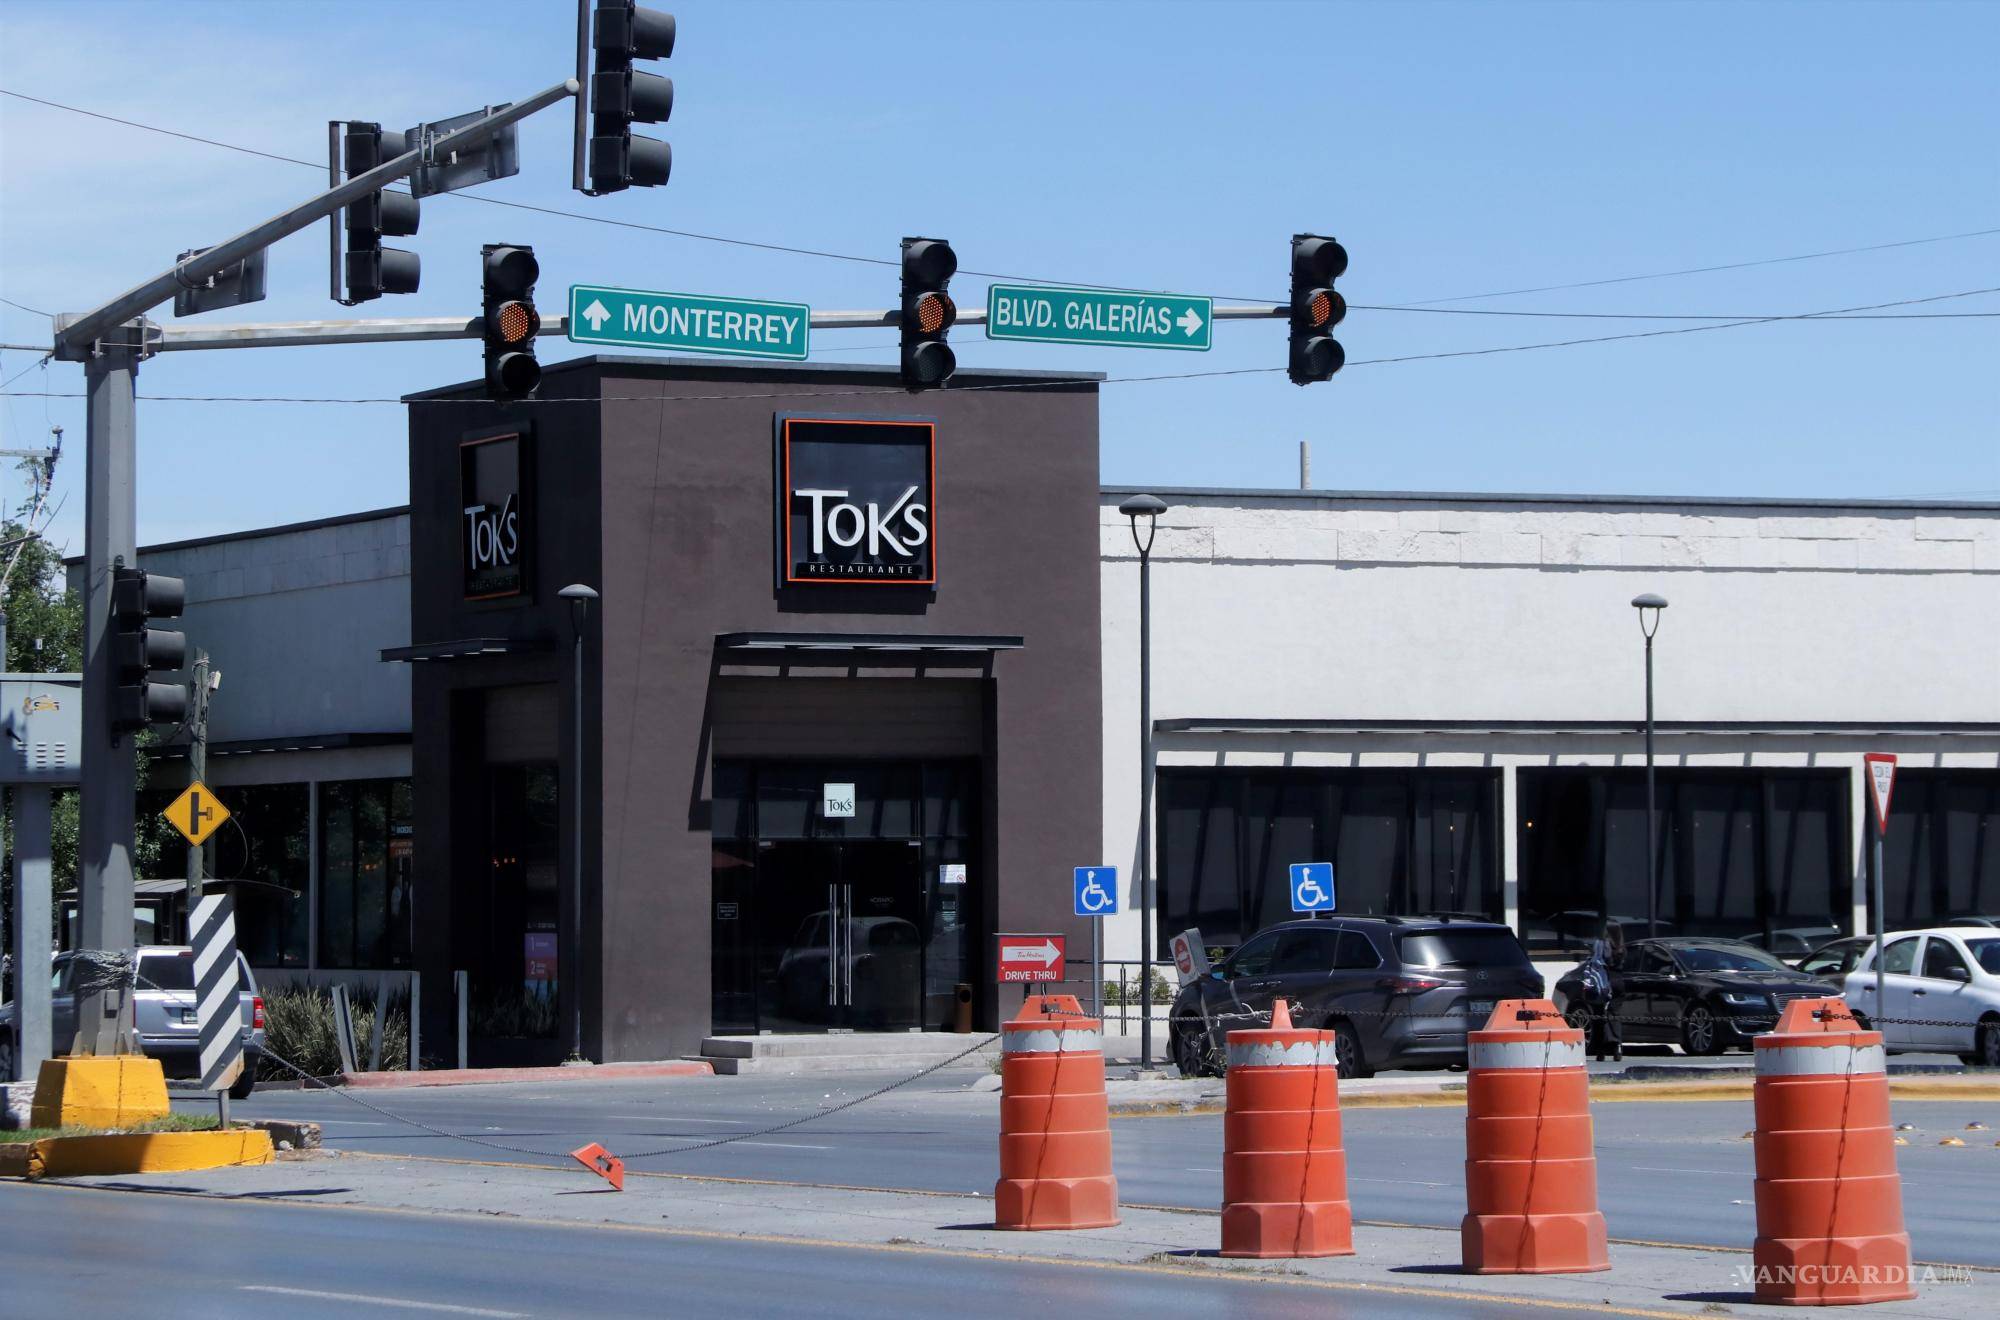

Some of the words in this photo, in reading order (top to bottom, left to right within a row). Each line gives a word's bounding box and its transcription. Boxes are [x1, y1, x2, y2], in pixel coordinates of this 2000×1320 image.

[624, 303, 799, 344] MONTERREY
[997, 298, 1057, 328] BLVD.
[1064, 299, 1172, 335] GALERÍAS
[810, 564, 913, 574] RESTAURANTE
[1005, 971, 1031, 980] DRIVE
[1033, 971, 1056, 980] THRU
